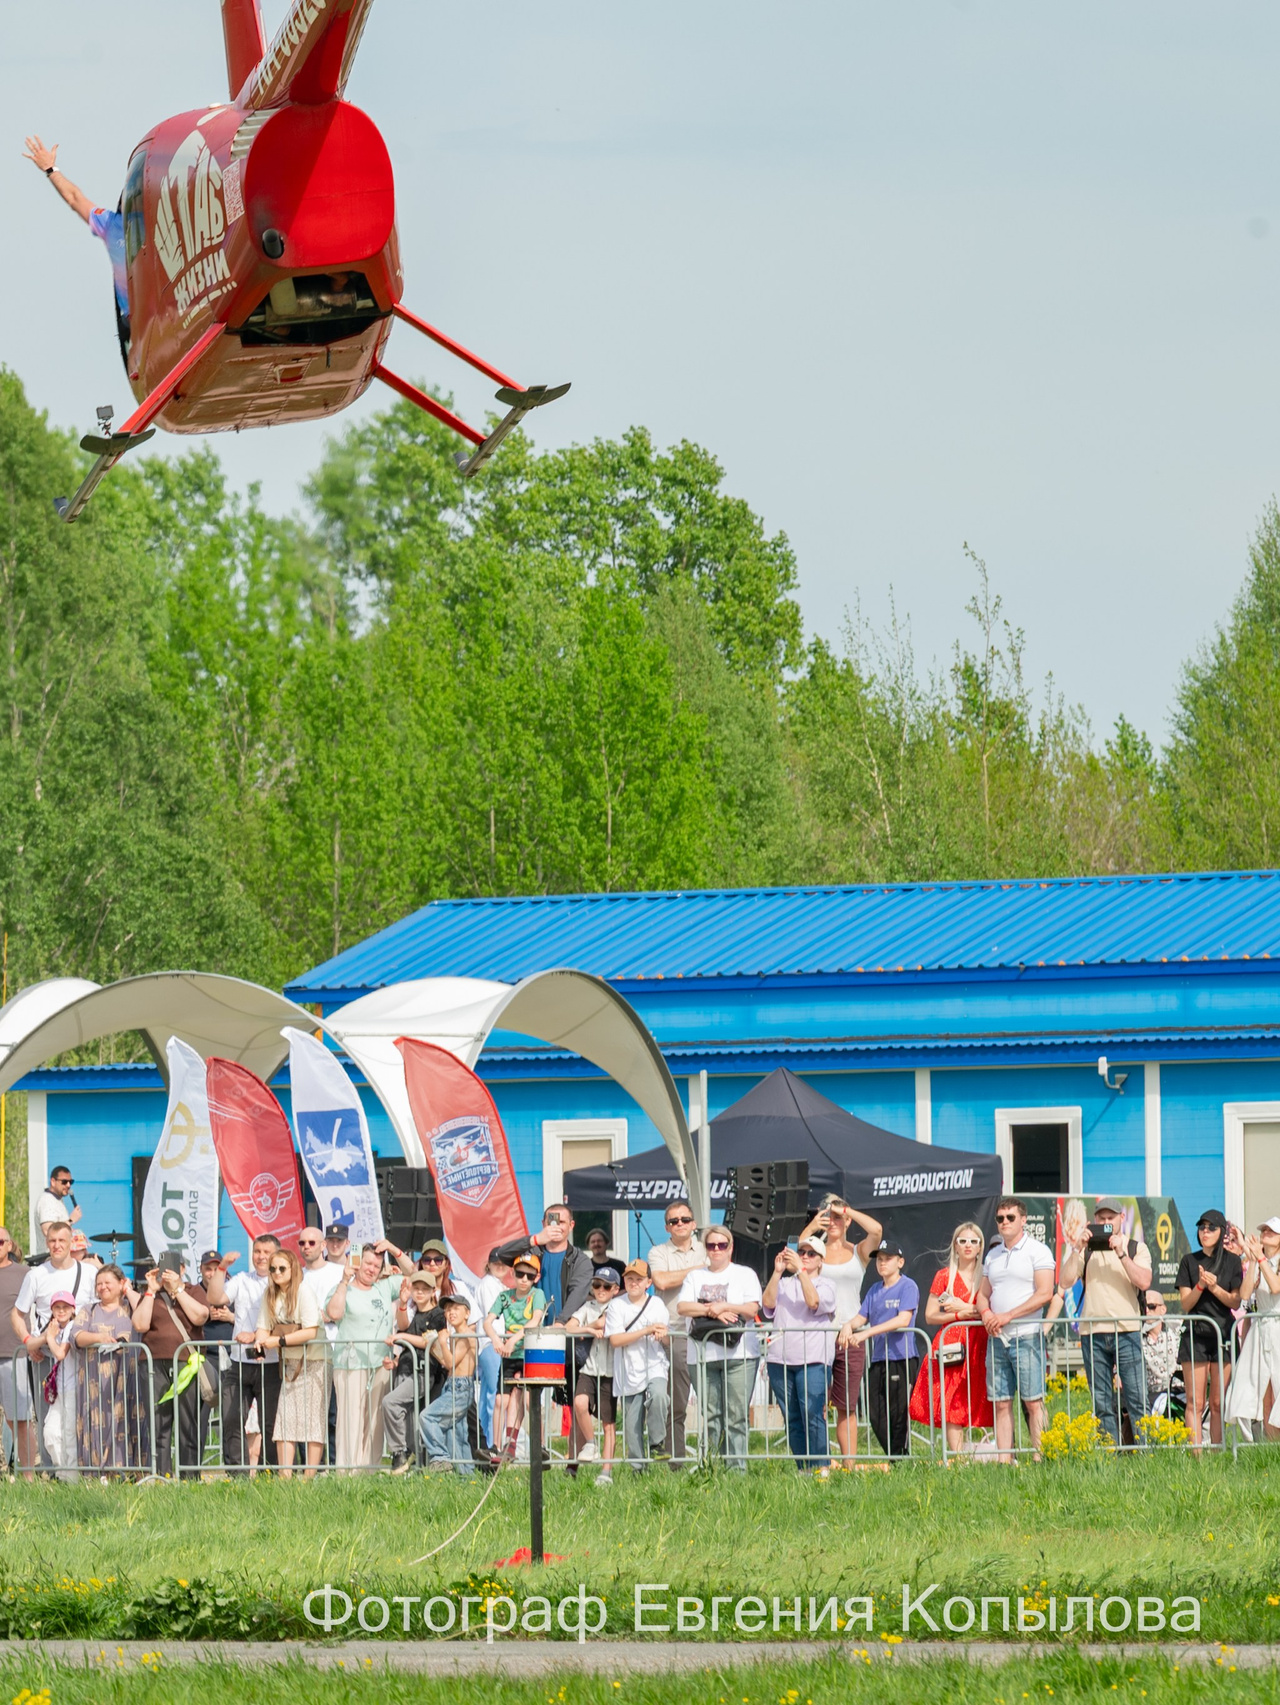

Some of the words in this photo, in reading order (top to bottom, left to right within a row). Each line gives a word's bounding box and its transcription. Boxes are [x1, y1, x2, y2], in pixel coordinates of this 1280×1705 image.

[154, 129, 225, 283] ШТАБ
[173, 248, 231, 317] ЖИЗНИ
[873, 1168, 974, 1197] TEXPRODUCTION
